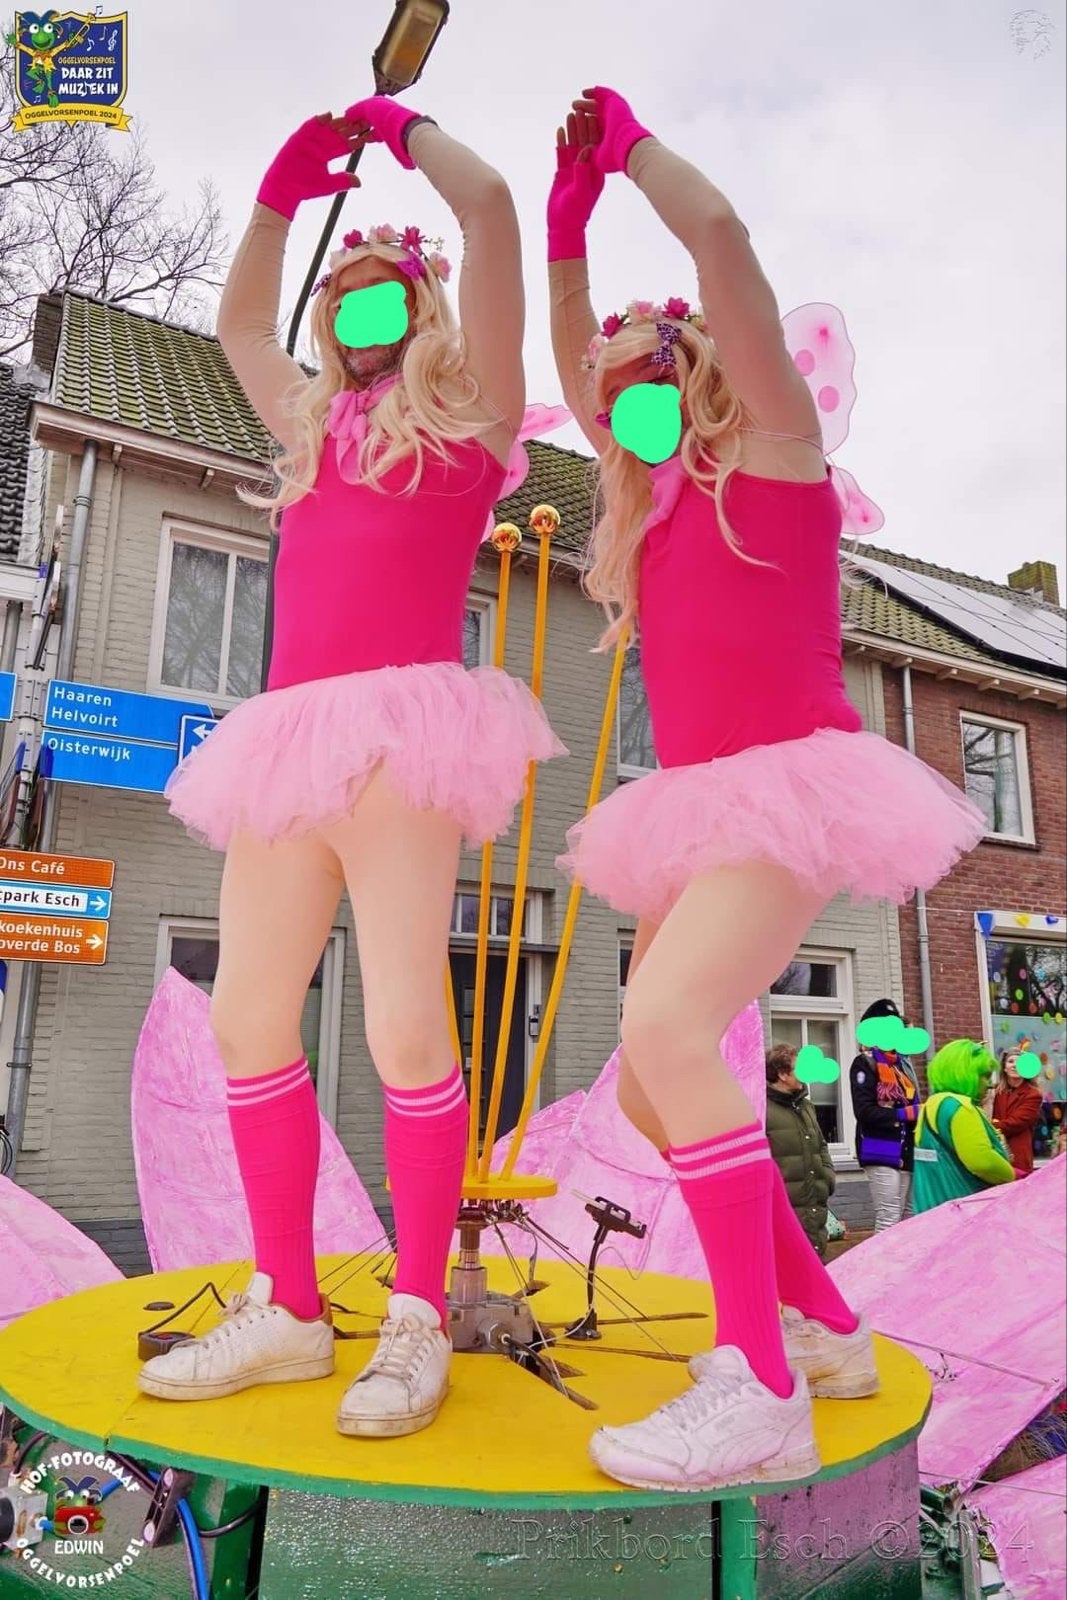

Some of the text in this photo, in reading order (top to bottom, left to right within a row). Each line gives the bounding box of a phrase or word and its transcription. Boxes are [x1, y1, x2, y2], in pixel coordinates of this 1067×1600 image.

[54, 686, 112, 707] Haaren
[51, 706, 118, 728] Helvoirt
[48, 737, 131, 762] Oisterwijk
[31, 860, 65, 875] Café
[45, 892, 80, 908] Esch
[0, 919, 83, 938] koekenhuis
[54, 940, 80, 954] Bos
